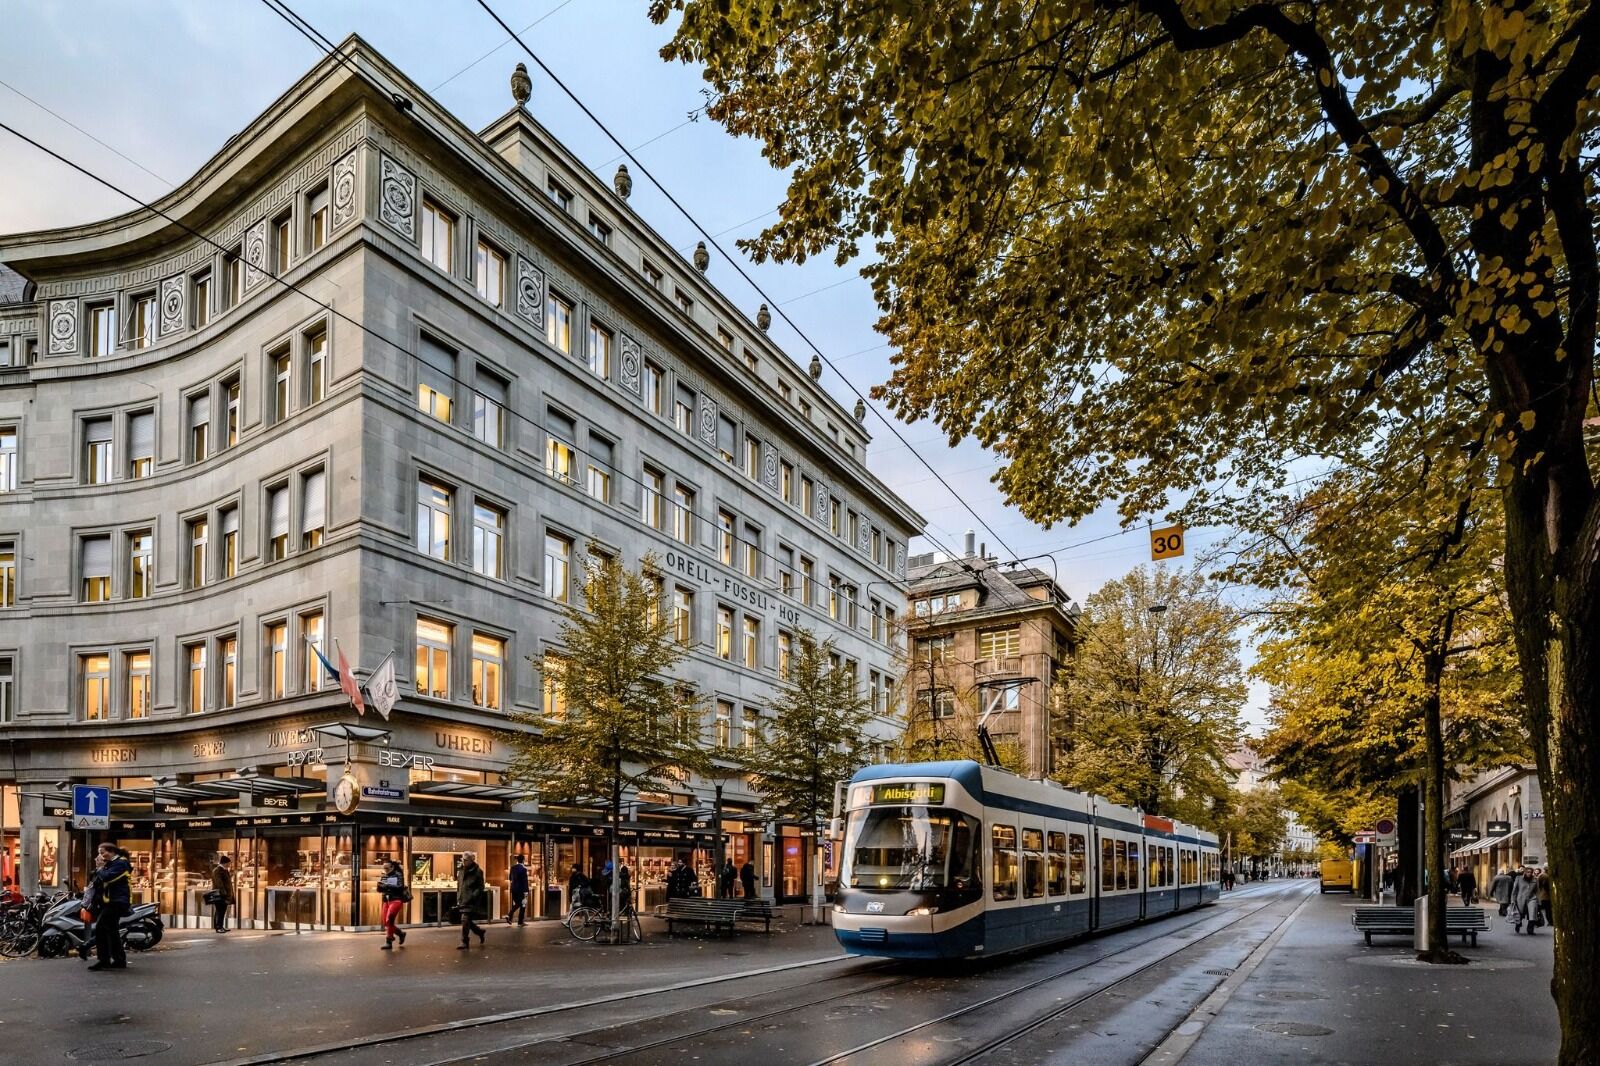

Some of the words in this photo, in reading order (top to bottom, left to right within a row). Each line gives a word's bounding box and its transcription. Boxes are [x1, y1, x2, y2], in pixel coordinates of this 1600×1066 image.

[1154, 534, 1181, 553] 30
[192, 740, 226, 758] BEYER
[435, 732, 492, 754] UHREN
[92, 748, 137, 763] UHREN
[287, 748, 325, 767] BEYER
[379, 750, 434, 771] BEYER
[164, 804, 188, 814] Juwelen
[263, 797, 288, 807] BEYER
